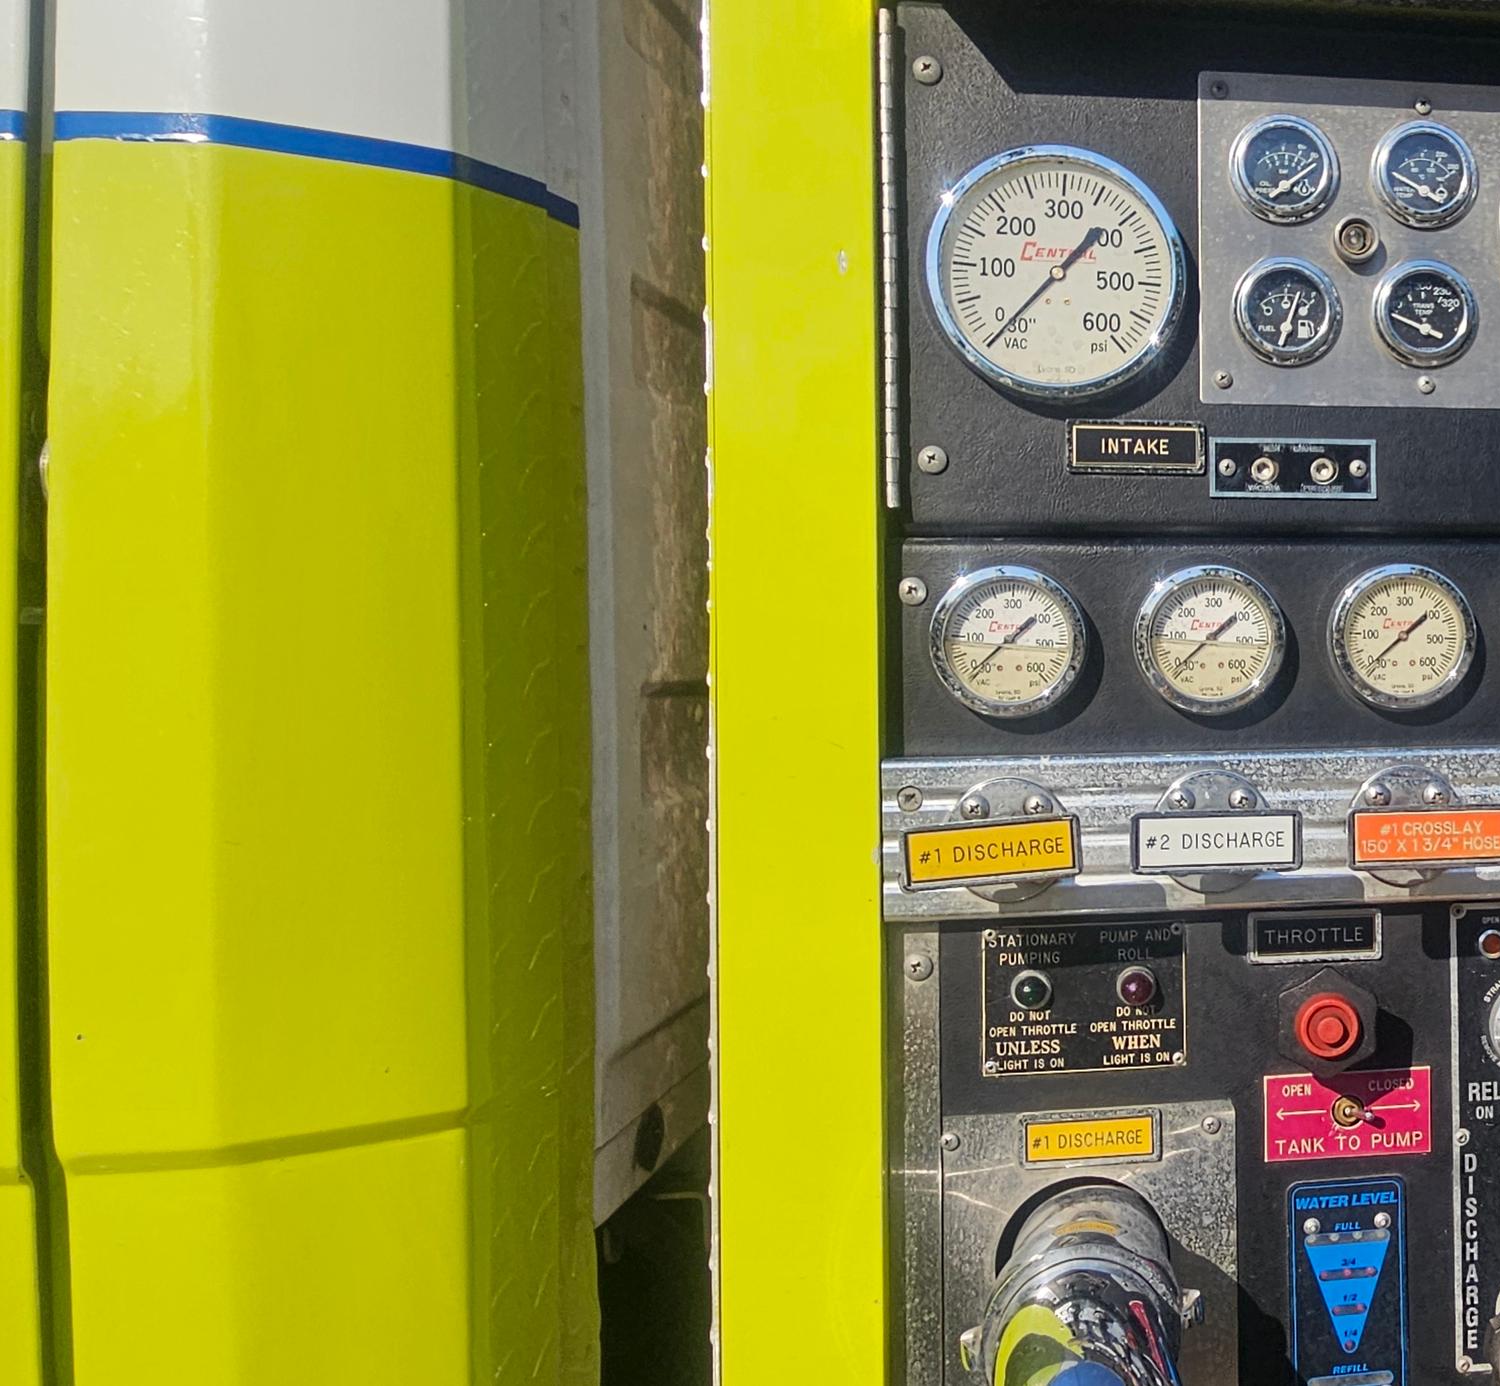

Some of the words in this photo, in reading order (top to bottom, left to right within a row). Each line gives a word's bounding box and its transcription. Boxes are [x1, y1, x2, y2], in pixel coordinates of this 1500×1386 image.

[1044, 200, 1083, 219] 300
[996, 217, 1036, 236] 200
[980, 258, 1015, 277] 100
[1097, 272, 1134, 291] 500
[1441, 299, 1459, 307] 320
[1083, 313, 1121, 332] 600
[1004, 338, 1027, 349] VAC
[1091, 341, 1107, 354] psi
[1101, 438, 1169, 455] INTAKE
[1205, 599, 1222, 607] 300
[1396, 597, 1413, 606] 300
[976, 609, 994, 618] 200
[1427, 635, 1443, 644] 500
[1228, 660, 1245, 669] 600
[1380, 825, 1399, 836] #1
[1403, 821, 1483, 835] CROSSLAY
[1146, 835, 1170, 850] #2
[1182, 832, 1284, 849] DISCHARGE
[1362, 839, 1391, 853] 150'
[1396, 839, 1406, 852] X
[920, 848, 942, 864] #1
[953, 837, 1065, 863] DISCHARGE
[989, 933, 1077, 947] STATIONARY
[1100, 931, 1137, 942] PUMP
[1145, 929, 1170, 941] AND
[1265, 927, 1363, 944] THROTTLE
[1000, 952, 1060, 965] PUMPING
[1118, 949, 1152, 960] ROLL
[1010, 1012, 1024, 1021] DO
[1029, 1011, 1050, 1020] NOT
[1117, 1007, 1131, 1016] DO
[990, 1027, 1016, 1037] OPEN
[1022, 1023, 1077, 1035] THROTTLE
[1090, 1022, 1116, 1032] OPEN
[1122, 1019, 1176, 1031] THROTTLE
[996, 1040, 1060, 1056] UNLESS
[1112, 1034, 1161, 1049] WHEN
[998, 1059, 1029, 1070] LIGHT
[1034, 1059, 1044, 1068] IS
[1051, 1058, 1064, 1067] ON
[1103, 1054, 1134, 1065] LIGHT
[1141, 1054, 1149, 1063] IS
[1153, 1052, 1169, 1062] ON
[1282, 1084, 1311, 1097] OPEN
[1369, 1078, 1414, 1090] CLOSED
[1476, 1105, 1493, 1119] ON
[1033, 1138, 1049, 1149] #1
[1058, 1129, 1143, 1149] DISCHARGE
[1275, 1138, 1324, 1155] TANK
[1335, 1135, 1359, 1150] TO
[1371, 1131, 1422, 1148] PUMP
[1296, 1195, 1348, 1210] WATER
[1352, 1192, 1398, 1206] LEVEL
[1335, 1222, 1361, 1231] FULL
[1465, 1154, 1478, 1349] DISCHARGE
[1344, 1329, 1357, 1337] 1/4
[1333, 1364, 1368, 1374] REFILL
